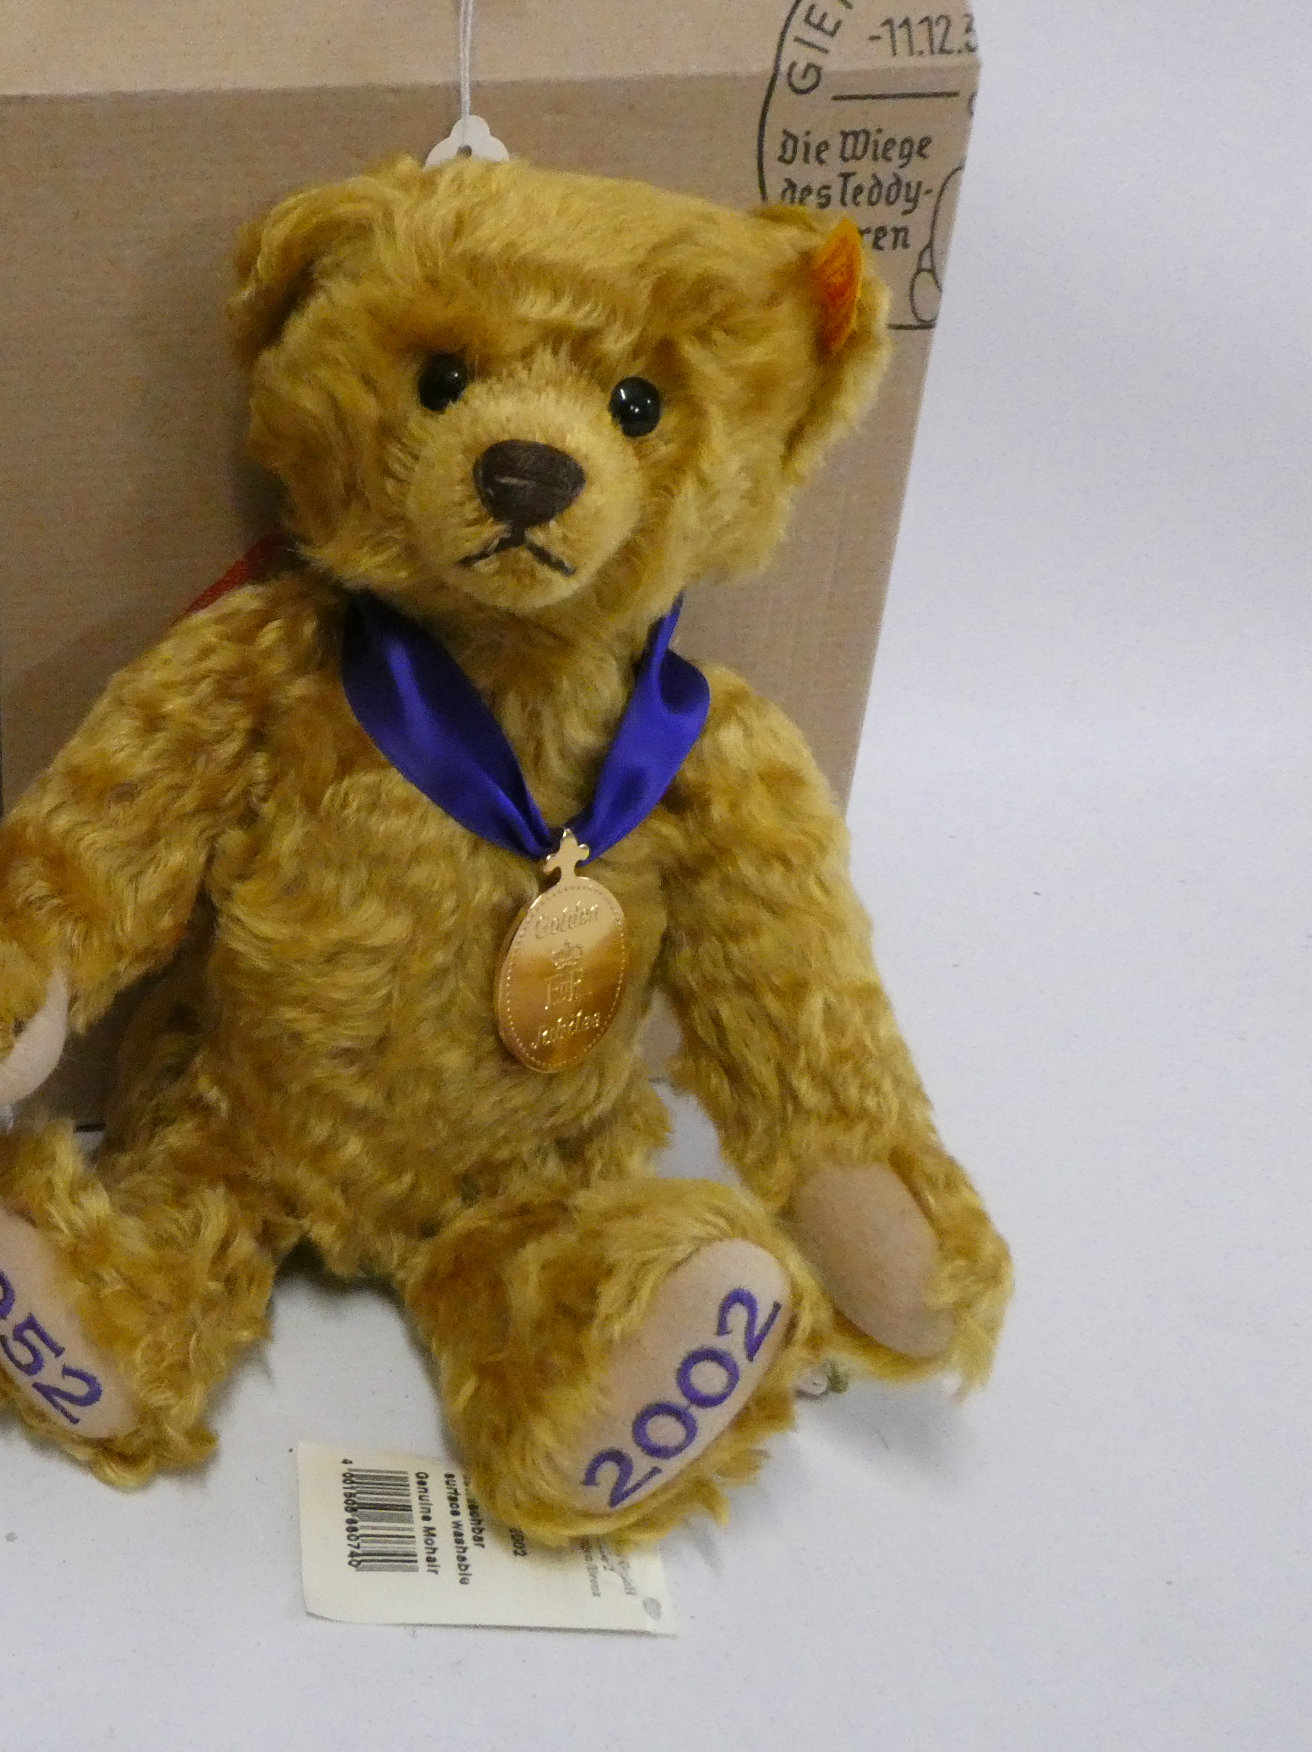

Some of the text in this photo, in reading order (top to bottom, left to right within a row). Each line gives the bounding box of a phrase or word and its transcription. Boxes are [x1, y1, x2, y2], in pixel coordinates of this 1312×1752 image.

[786, 0, 854, 96] GIE
[777, 127, 933, 169] Die Wiege
[855, 223, 912, 251] ren
[580, 1286, 783, 1509] 2002
[415, 1471, 441, 1576] Genuine Mohair
[444, 1472, 462, 1517] surface
